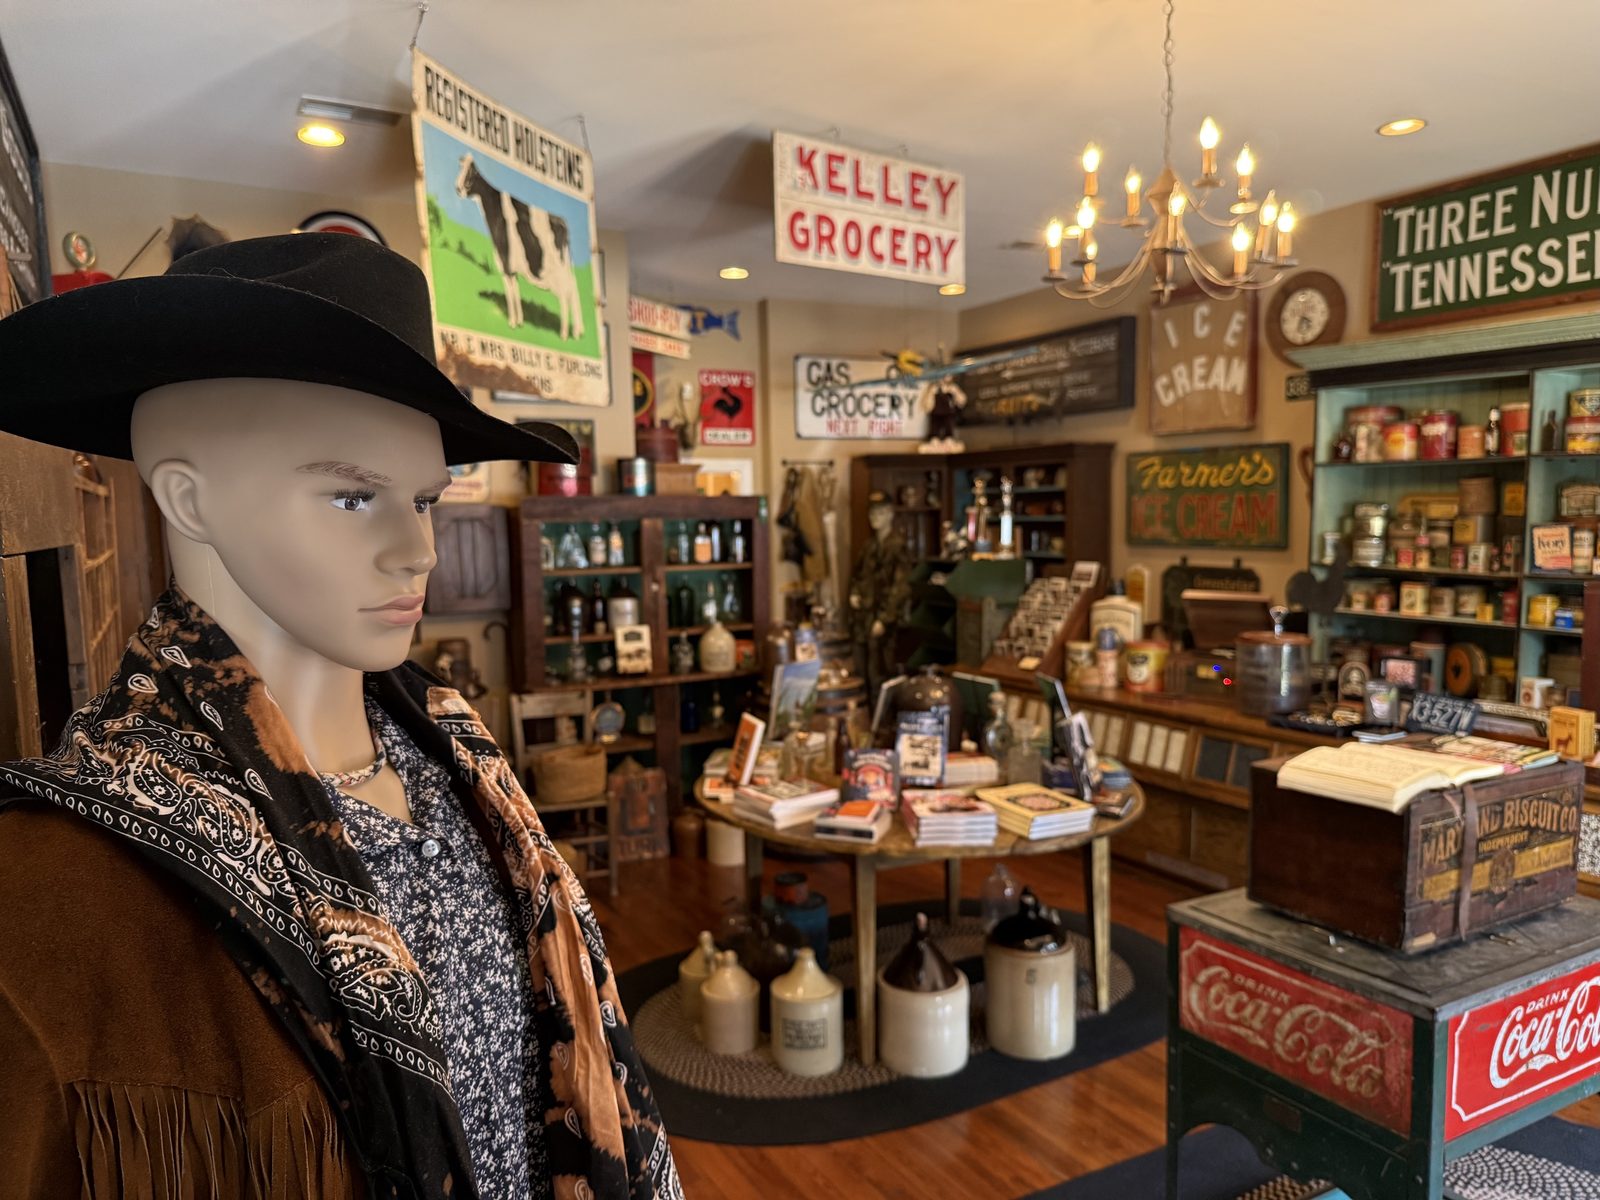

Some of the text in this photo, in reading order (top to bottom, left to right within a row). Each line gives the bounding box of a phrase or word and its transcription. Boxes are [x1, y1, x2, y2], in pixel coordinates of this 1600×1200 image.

[425, 65, 583, 190] REGISTERED HOLSTEINS
[797, 146, 957, 215] KELLEY
[1530, 167, 1600, 229] NU
[788, 211, 957, 273] GROCERY
[1164, 304, 1246, 348] ICE
[511, 347, 541, 367] BILLY
[806, 361, 850, 388] GAS
[1155, 355, 1248, 407] CREAM
[811, 391, 919, 419] GROCERY
[1136, 451, 1275, 490] Farmer's
[1175, 490, 1277, 541] CREAM
[1503, 798, 1561, 833] BISCUIT
[1478, 829, 1530, 854] INDEPENDENT
[1233, 973, 1292, 1003] DRINK
[1525, 987, 1570, 1014] DRINK
